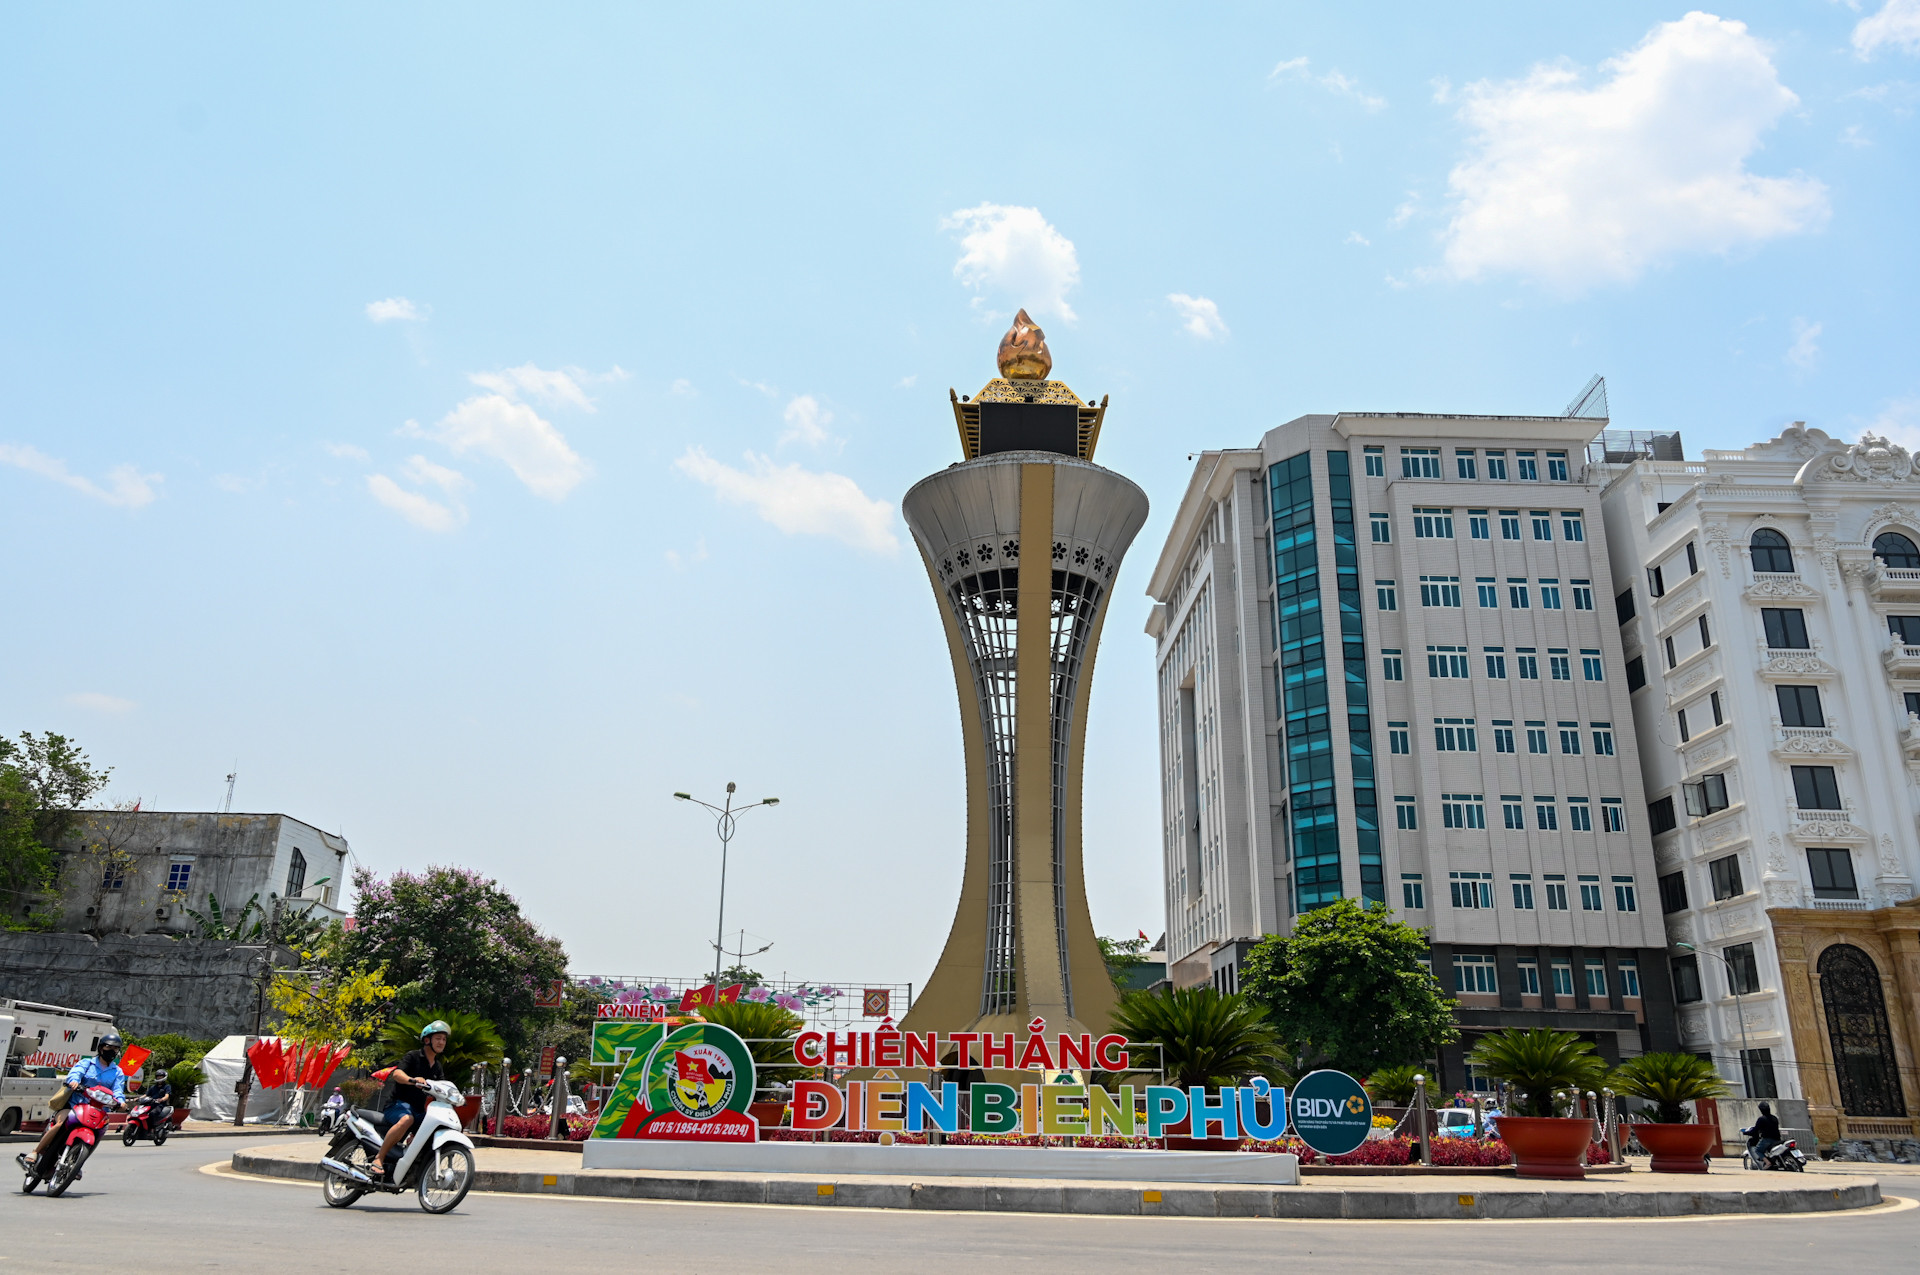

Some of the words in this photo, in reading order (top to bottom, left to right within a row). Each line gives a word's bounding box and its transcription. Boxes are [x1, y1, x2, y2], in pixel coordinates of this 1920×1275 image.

[597, 997, 620, 1018] KỶ
[622, 998, 665, 1022] NIỆM
[63, 1029, 79, 1043] VTV
[793, 1016, 938, 1069] CHIẾN
[949, 1015, 1130, 1073] THẮNG
[46, 1052, 61, 1068] DU
[693, 1048, 712, 1056] XUÂN
[714, 1053, 726, 1067] 1954
[788, 1069, 958, 1147] ĐIỆN
[970, 1074, 1136, 1137] BIÊN
[1145, 1076, 1287, 1141] PHỦ
[1296, 1098, 1347, 1118] BIDV
[648, 1121, 750, 1138] (07/5/1954-07/5/2024)
